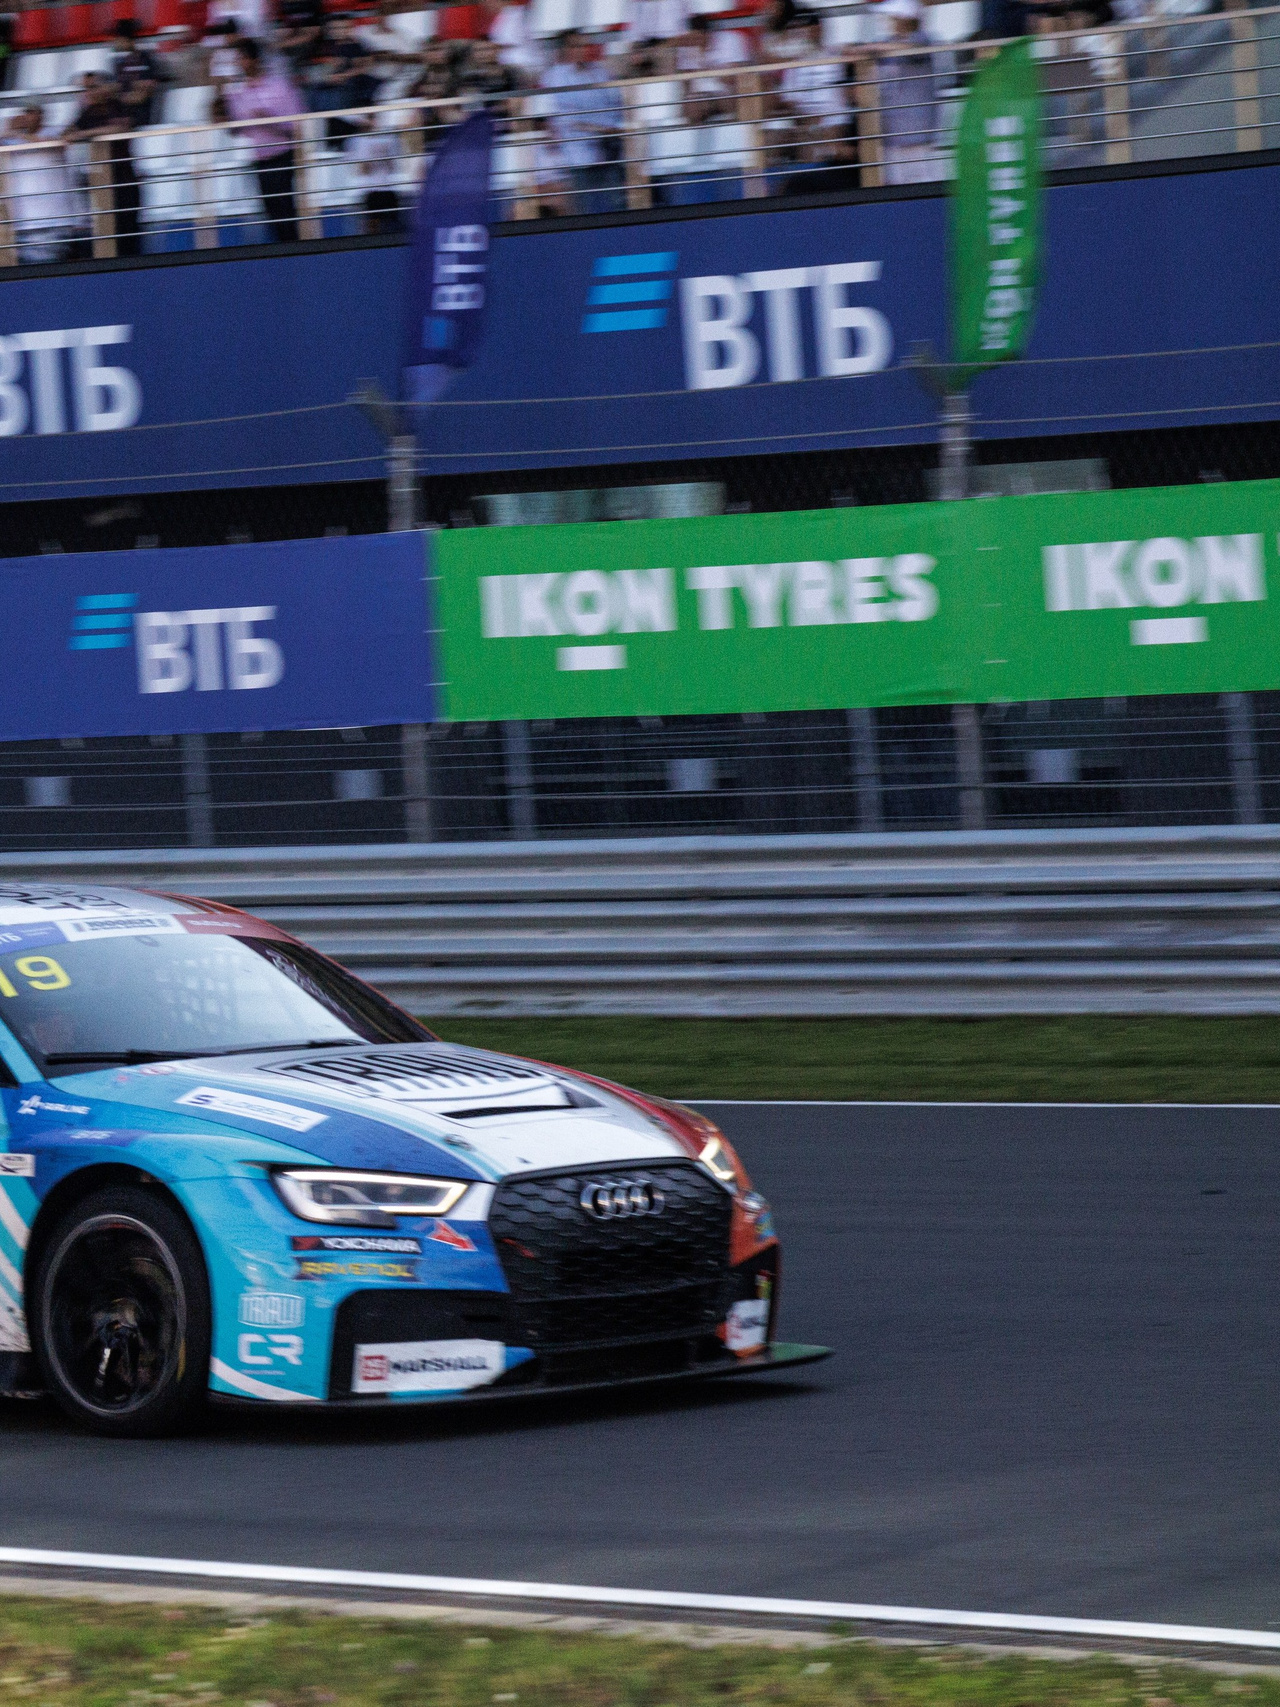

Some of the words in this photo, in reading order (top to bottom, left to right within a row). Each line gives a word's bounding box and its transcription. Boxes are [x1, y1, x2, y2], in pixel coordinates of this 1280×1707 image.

[431, 224, 489, 311] ВТБ
[679, 261, 895, 391] ВТБ
[478, 567, 676, 638] IKON
[685, 554, 942, 630] TYRES
[1042, 533, 1267, 612] IKON
[133, 605, 284, 694] ВТБ
[238, 1333, 304, 1365] CR
